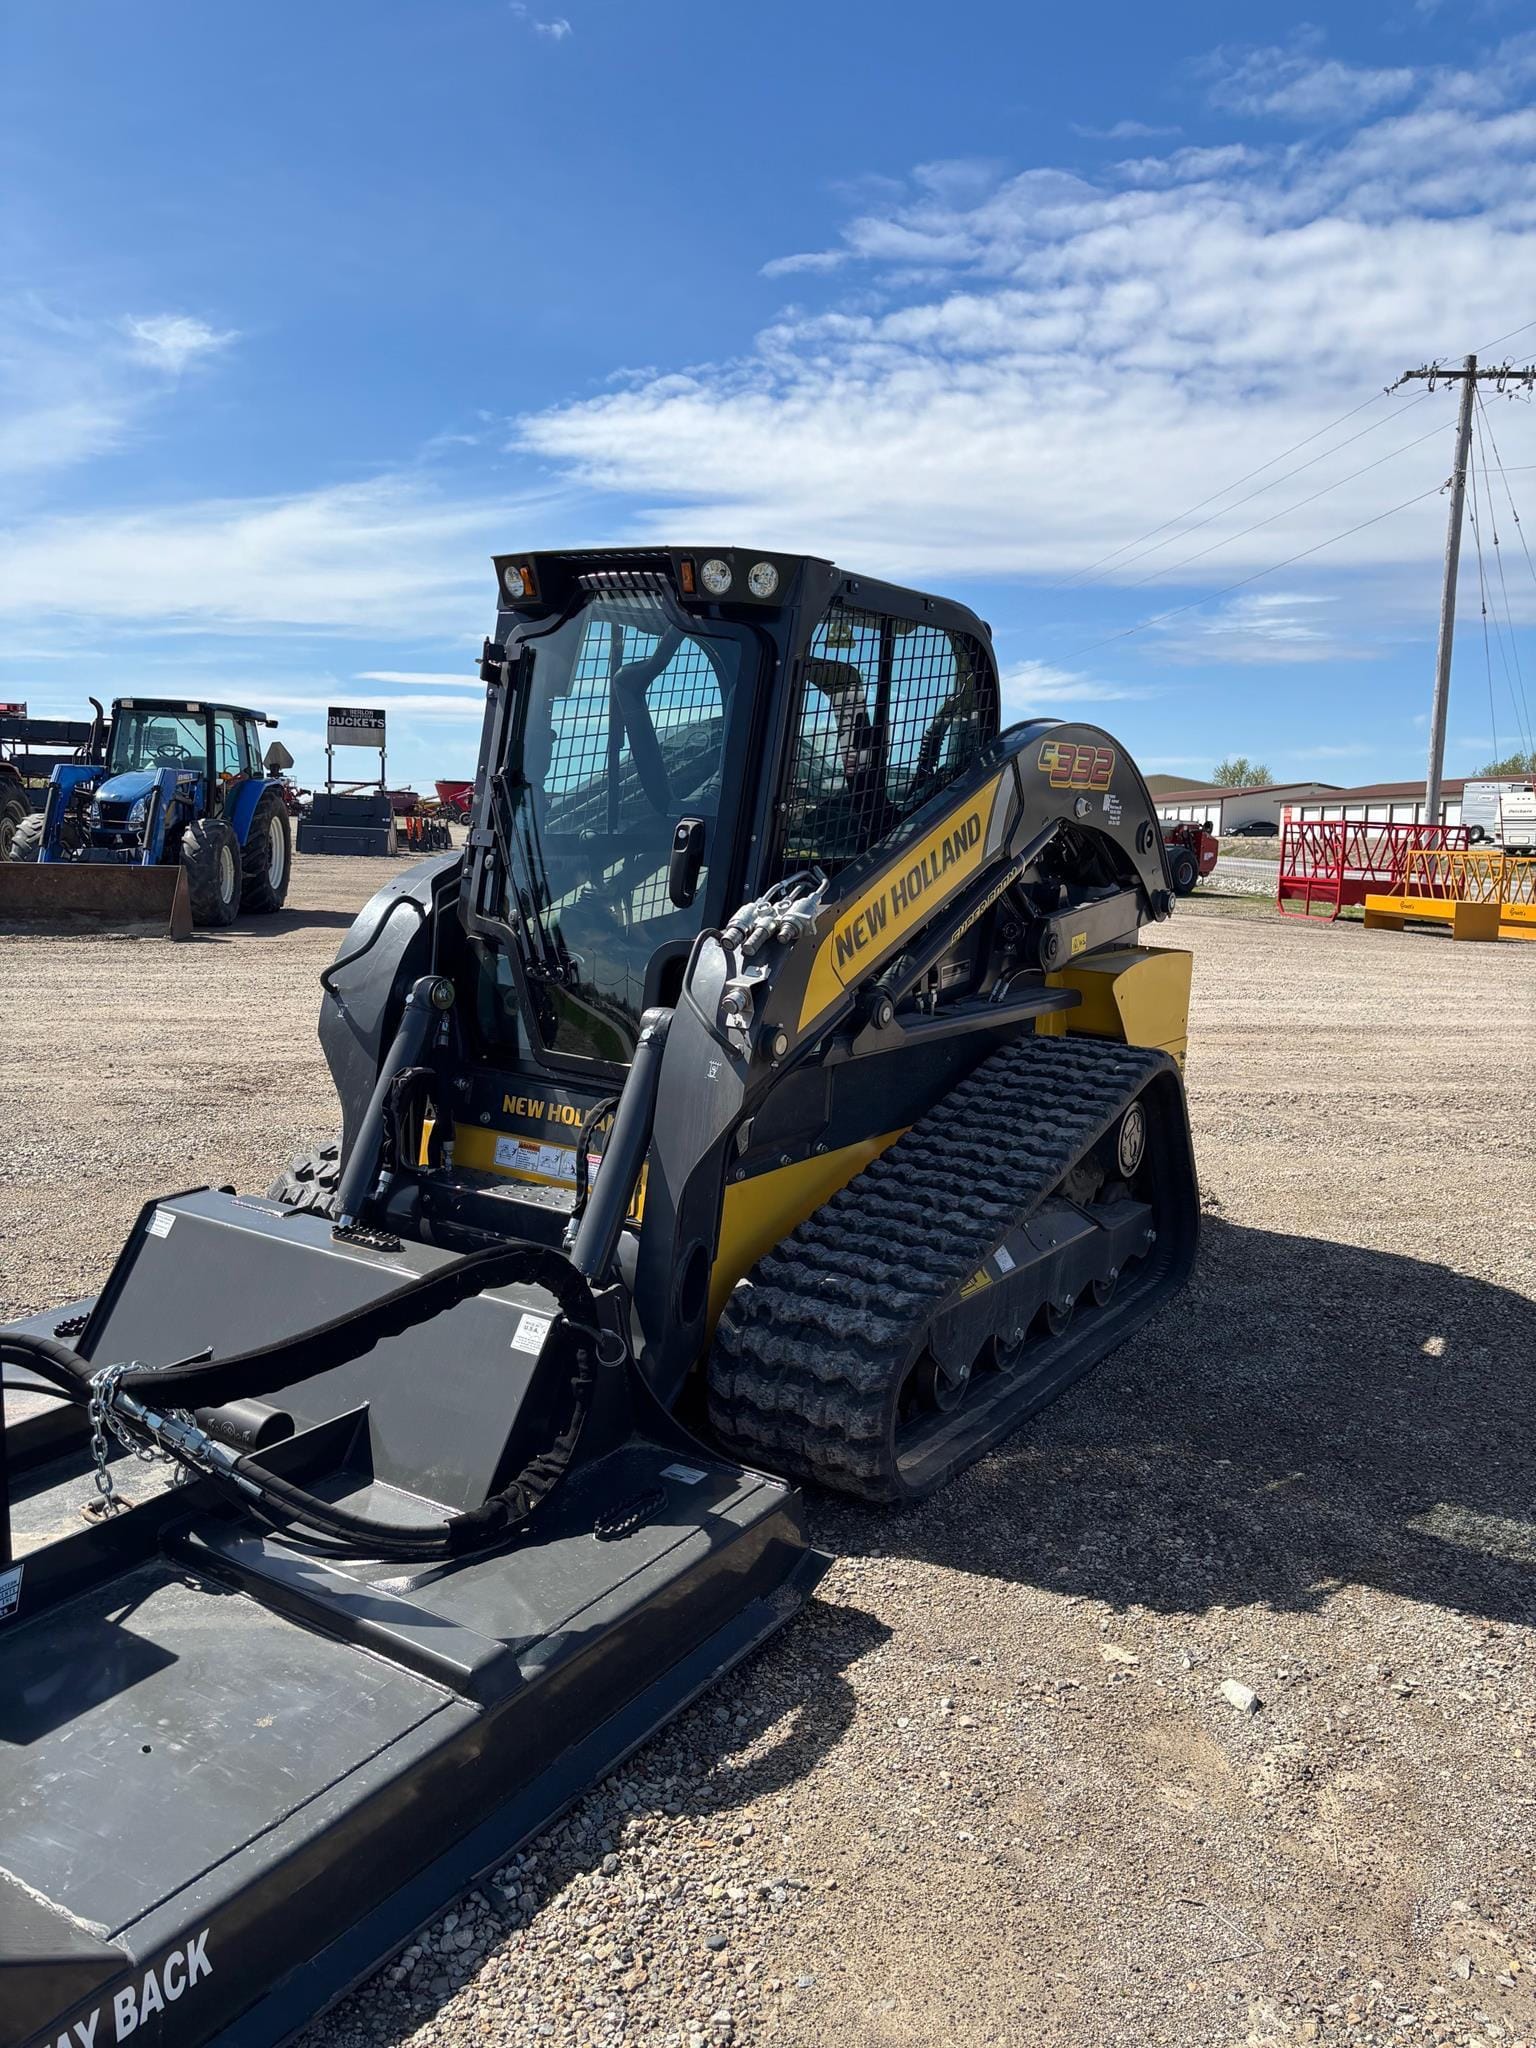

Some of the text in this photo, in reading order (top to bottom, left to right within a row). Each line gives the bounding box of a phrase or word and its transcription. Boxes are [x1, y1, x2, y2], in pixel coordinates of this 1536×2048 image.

[328, 716, 385, 728] BUCKETS
[834, 812, 981, 968] NEW HOLLAND
[502, 1094, 615, 1132] NEW HOLA
[113, 1927, 214, 2043] BACK
